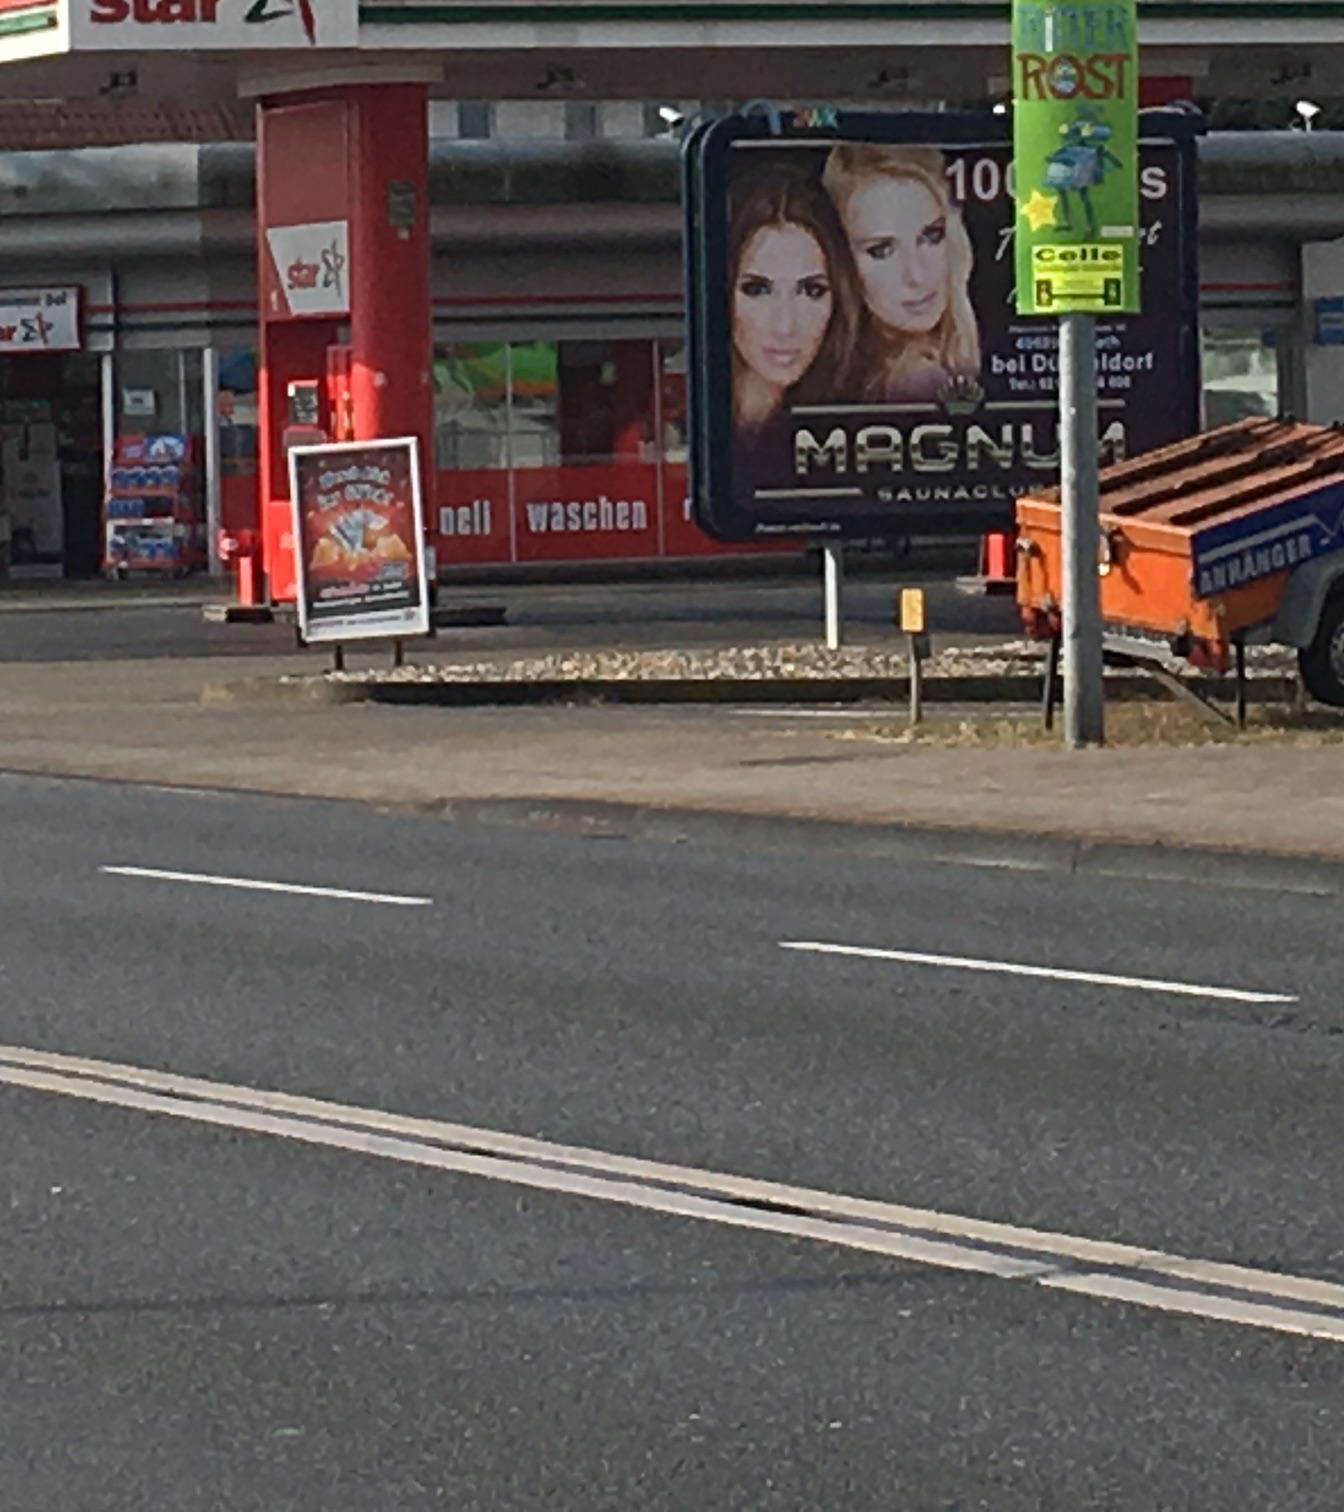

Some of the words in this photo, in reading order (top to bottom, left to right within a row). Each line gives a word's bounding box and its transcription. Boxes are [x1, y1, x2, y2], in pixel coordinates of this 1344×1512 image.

[1017, 53, 1131, 100] ROST
[287, 255, 320, 290] star
[526, 496, 647, 532] waschen
